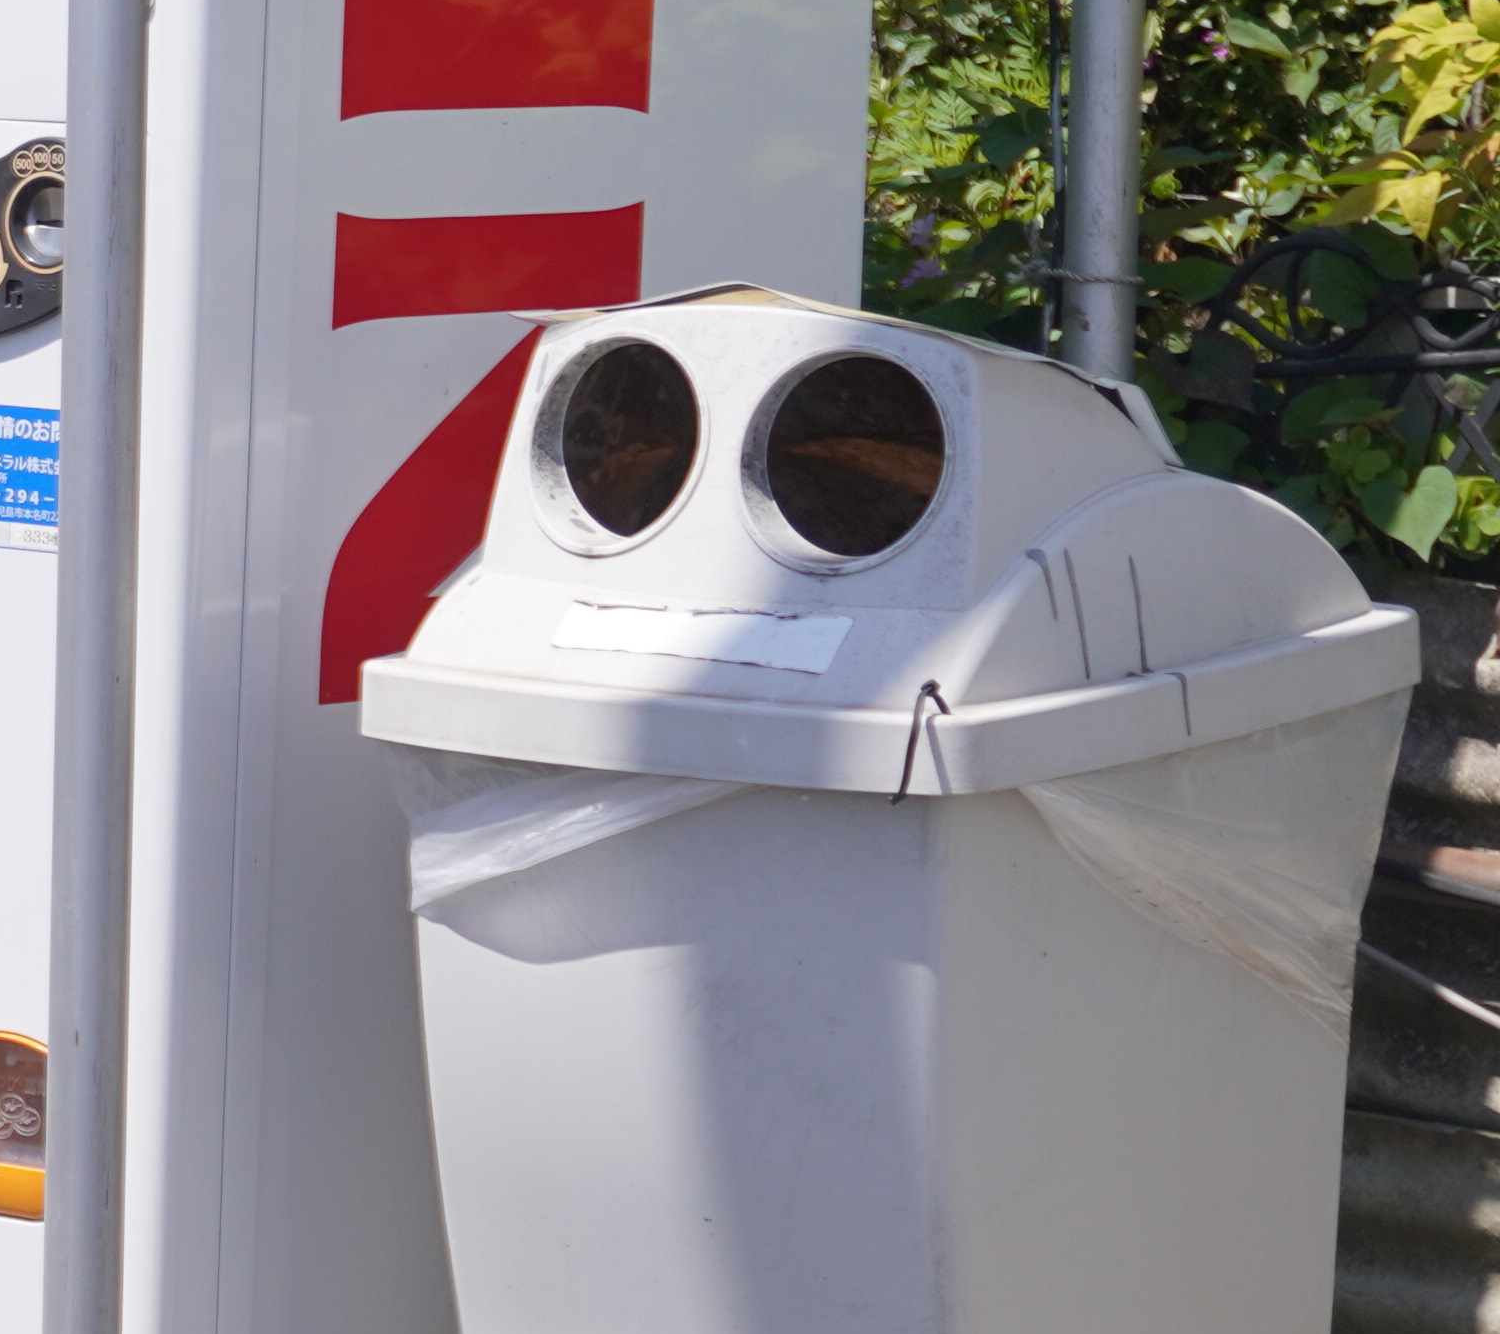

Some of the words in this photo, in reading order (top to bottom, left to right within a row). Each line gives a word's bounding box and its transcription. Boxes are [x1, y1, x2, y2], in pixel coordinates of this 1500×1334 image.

[15, 158, 32, 169] 500
[33, 153, 48, 164] 100
[52, 154, 63, 164] 50
